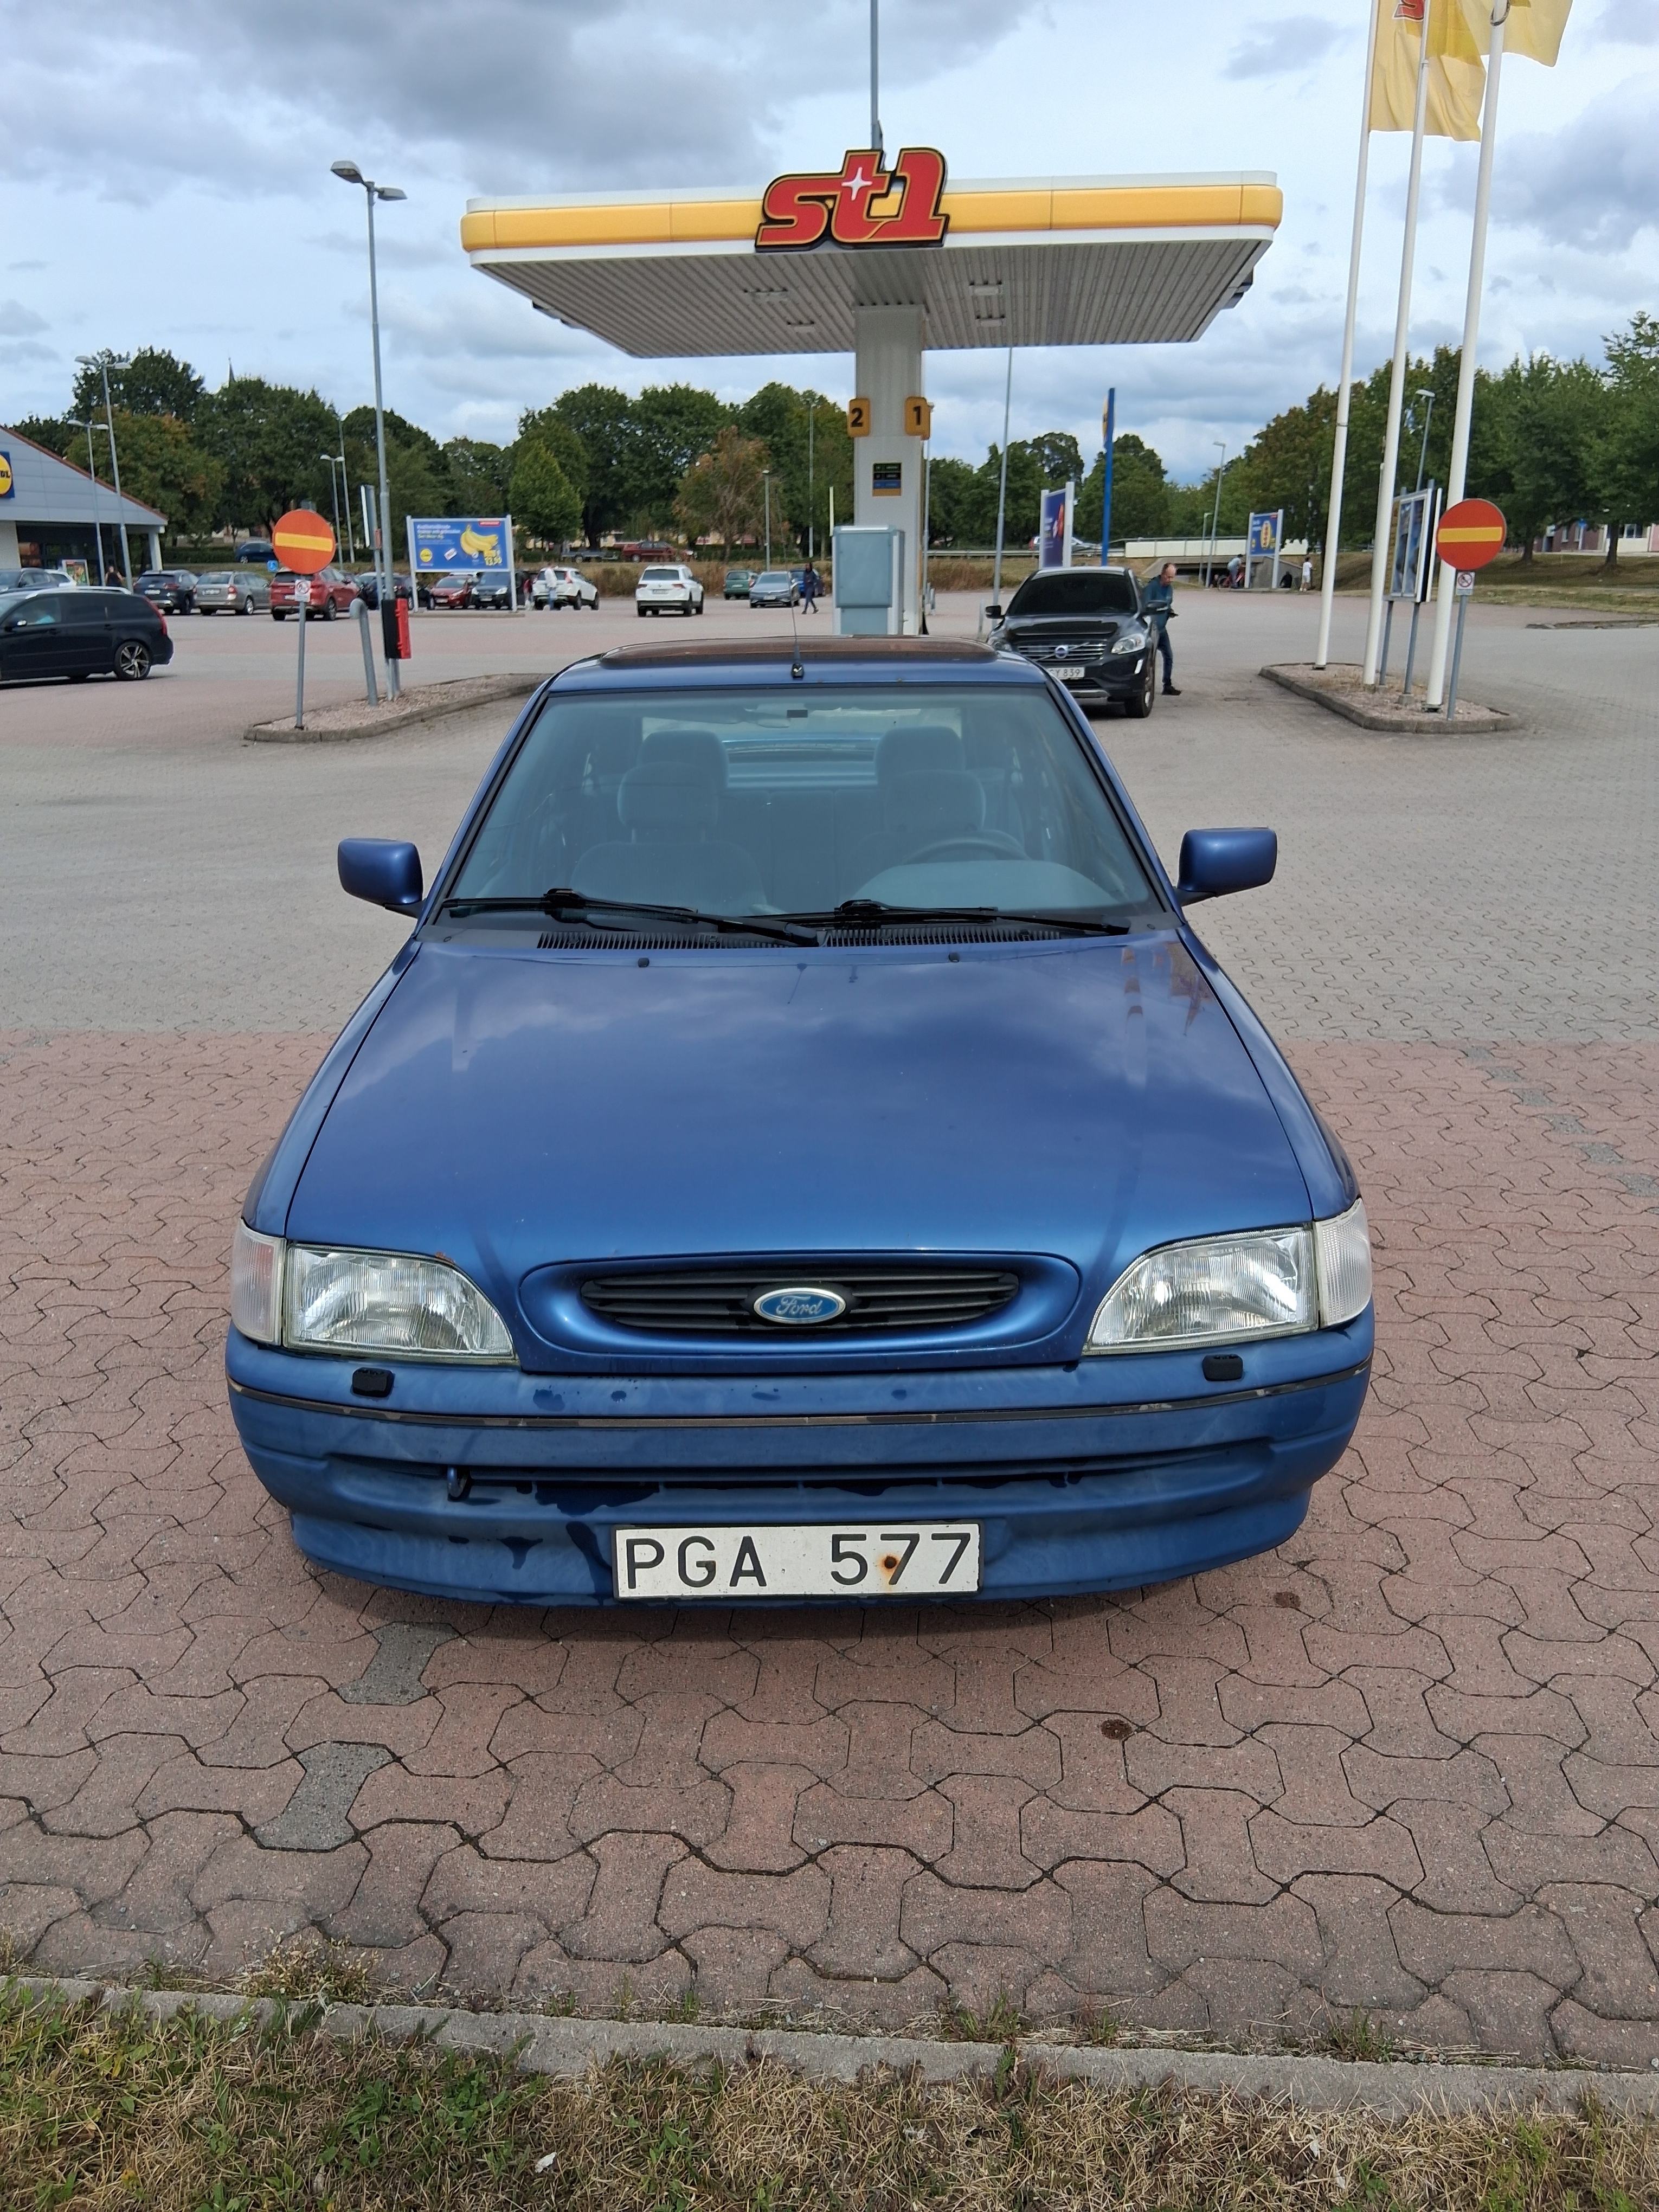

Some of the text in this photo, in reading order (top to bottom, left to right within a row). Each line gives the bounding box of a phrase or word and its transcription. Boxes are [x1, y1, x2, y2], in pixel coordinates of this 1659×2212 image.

[851, 408, 863, 427] 2
[913, 406, 921, 426] 1
[1063, 668, 1080, 677] 839
[776, 1295, 823, 1315] Ford
[626, 1533, 971, 1589] PGA 577
